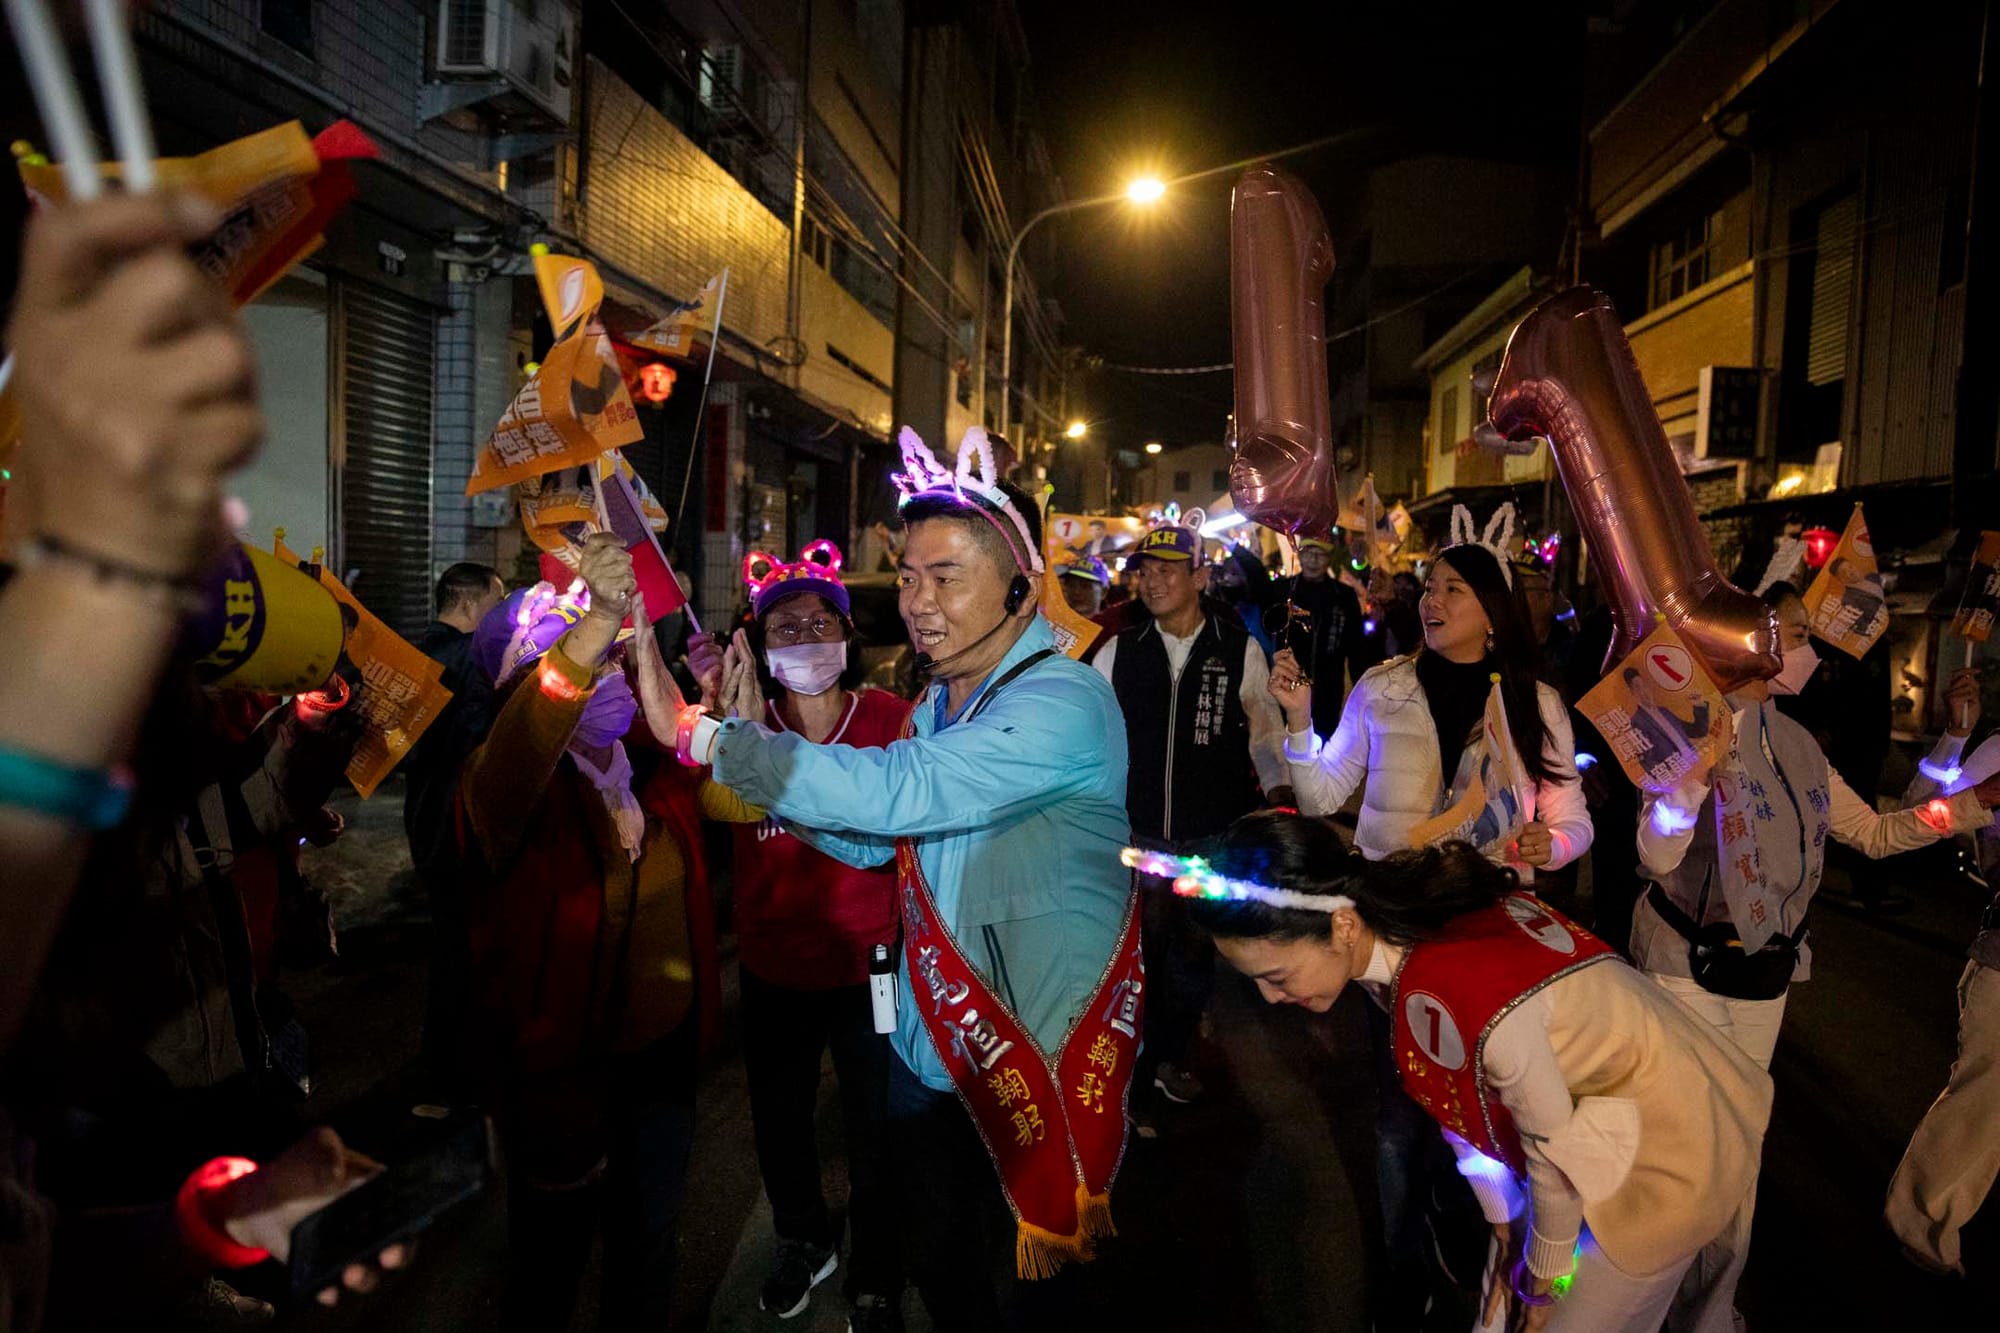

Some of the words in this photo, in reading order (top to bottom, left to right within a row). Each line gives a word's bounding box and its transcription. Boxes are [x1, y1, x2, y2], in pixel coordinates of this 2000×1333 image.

[1062, 521, 1073, 537] 1
[1102, 946, 1145, 1040] 恒
[1424, 1004, 1441, 1058] 1
[986, 1066, 1046, 1147] 鞠躬
